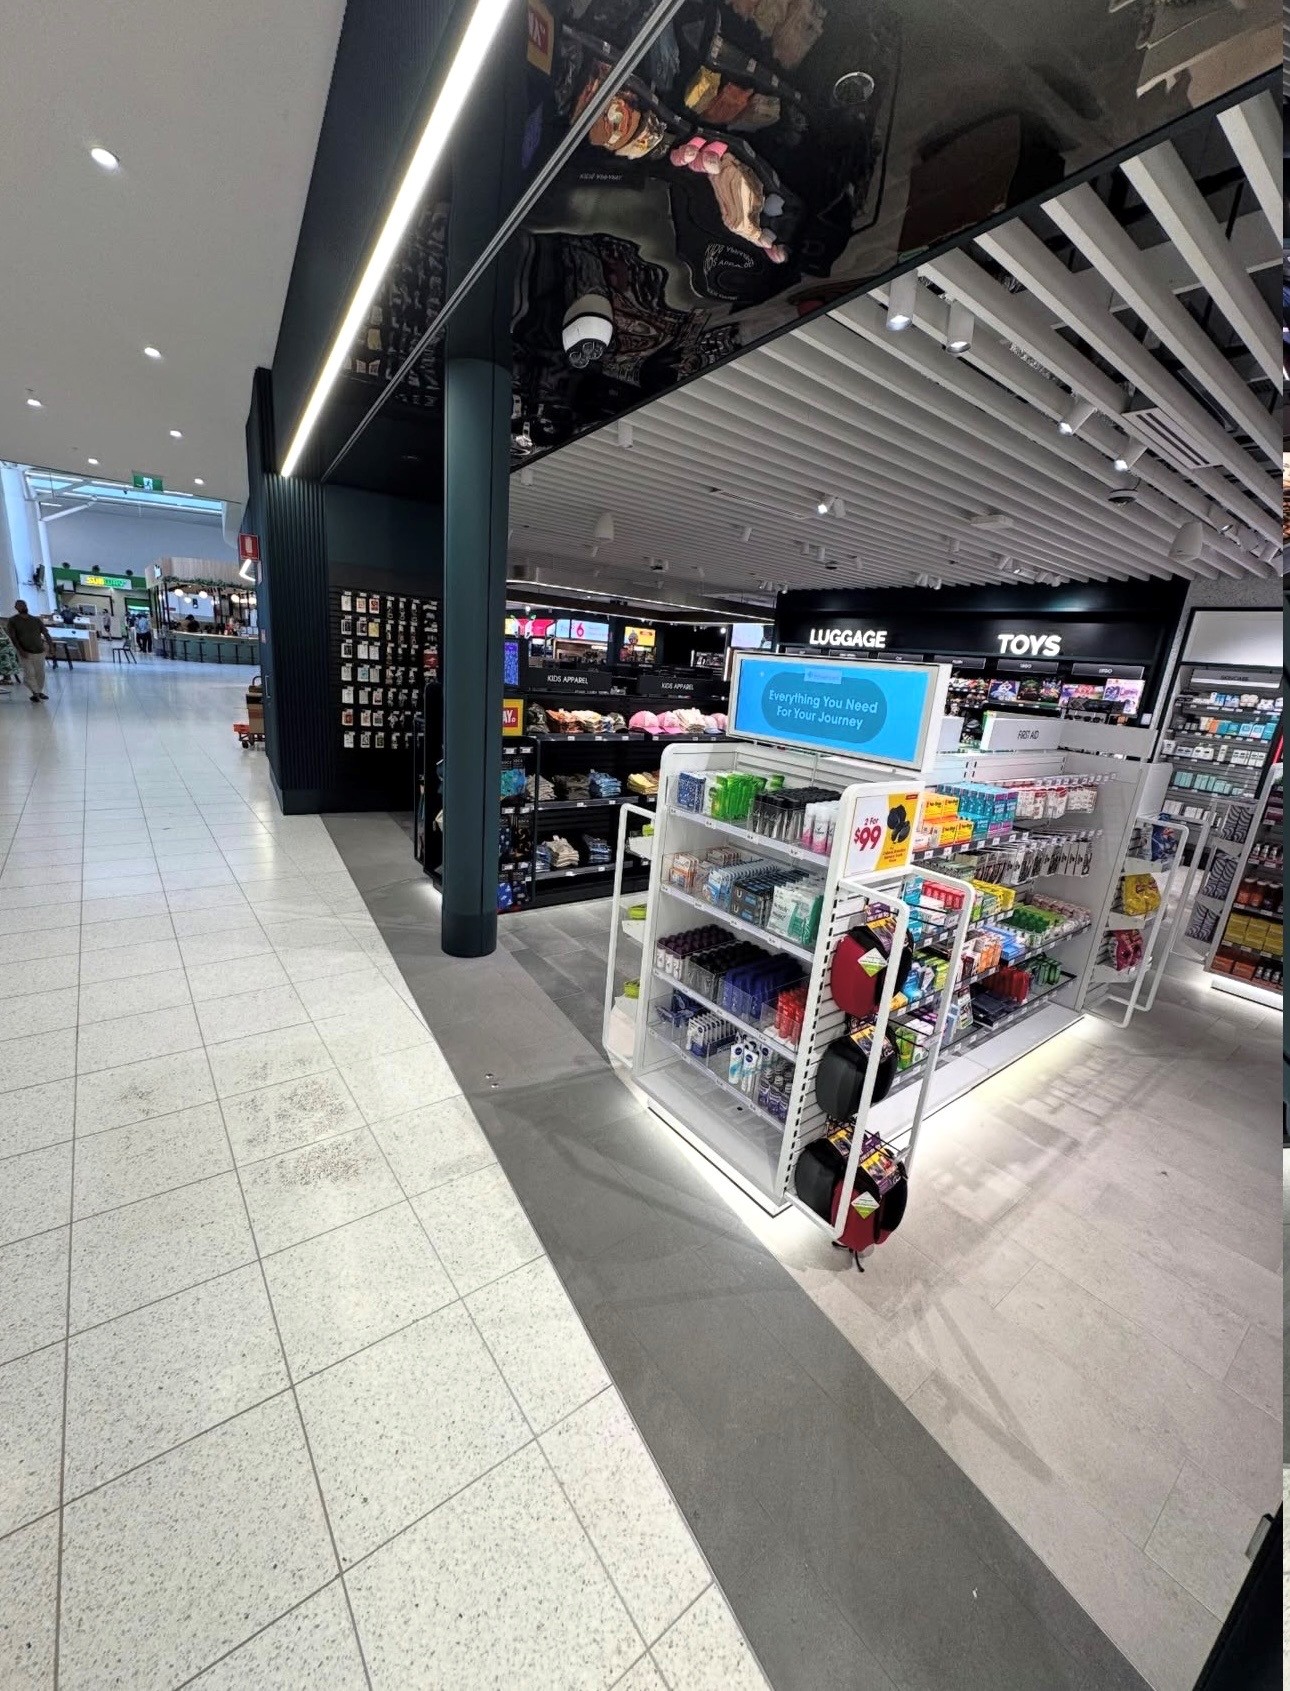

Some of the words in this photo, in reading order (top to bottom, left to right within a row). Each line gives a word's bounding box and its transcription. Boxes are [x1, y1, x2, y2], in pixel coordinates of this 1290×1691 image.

[810, 629, 888, 648] LUGGAGE
[997, 634, 1062, 656] TOYS
[563, 676, 588, 684] APPAREL
[769, 690, 820, 706] Everything
[823, 696, 843, 709] You
[846, 699, 878, 714] Need
[776, 705, 792, 717] For
[794, 708, 816, 722] Your
[818, 711, 863, 730] Journey
[1018, 730, 1030, 739] FIRST
[870, 817, 879, 825] For
[854, 826, 881, 851] $99
